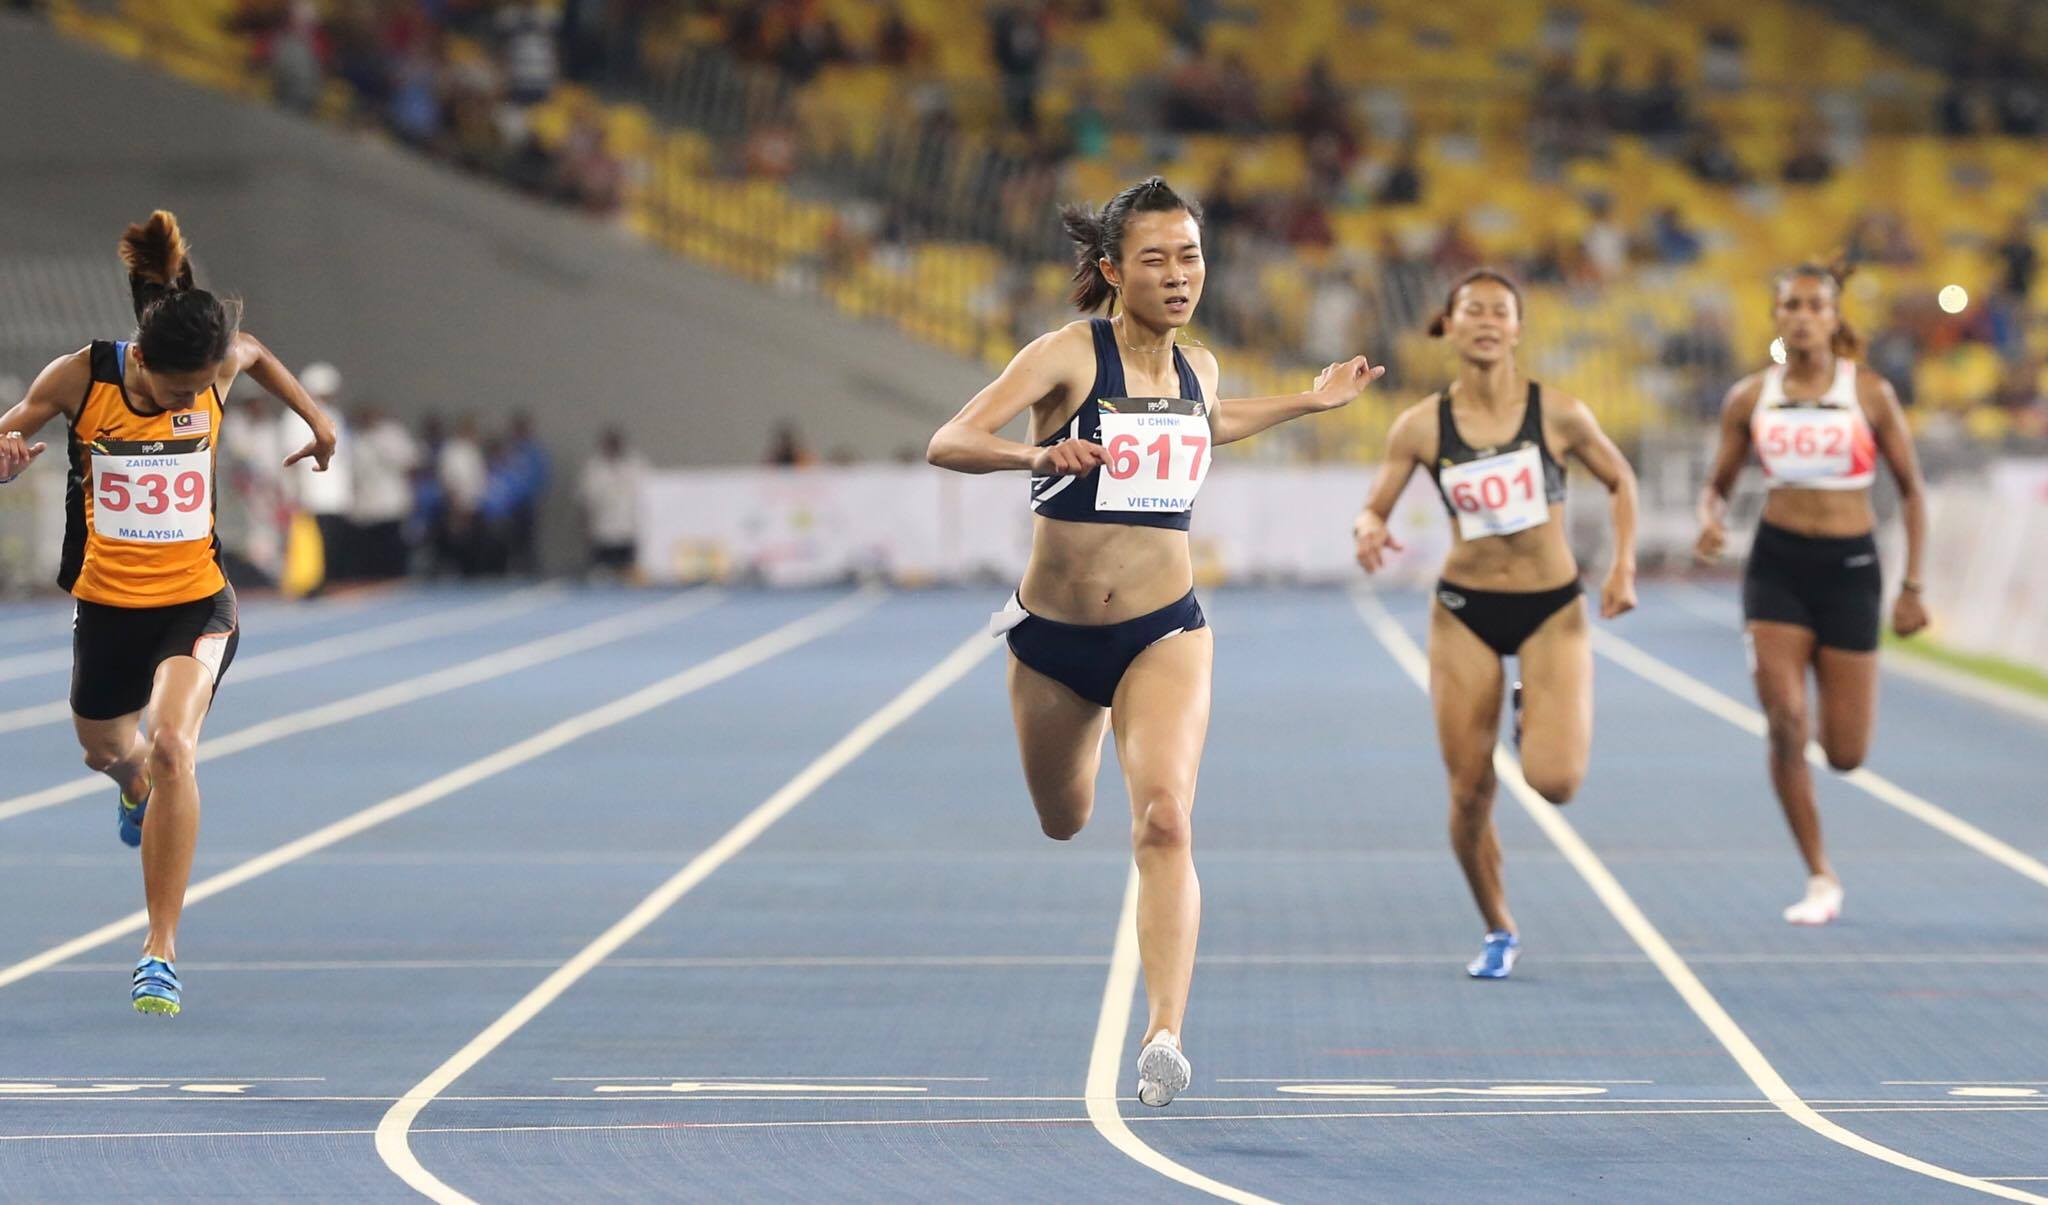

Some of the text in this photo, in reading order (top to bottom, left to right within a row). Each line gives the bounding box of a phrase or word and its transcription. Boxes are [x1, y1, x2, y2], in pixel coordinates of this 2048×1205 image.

[1107, 434, 1208, 480] 617
[1766, 426, 1844, 459] 562
[126, 457, 180, 468] ZAIDATUL
[98, 471, 205, 515] 539
[1127, 497, 1189, 508] VIETNAM
[1452, 467, 1534, 513] 601
[118, 528, 185, 540] MALAYSIA
